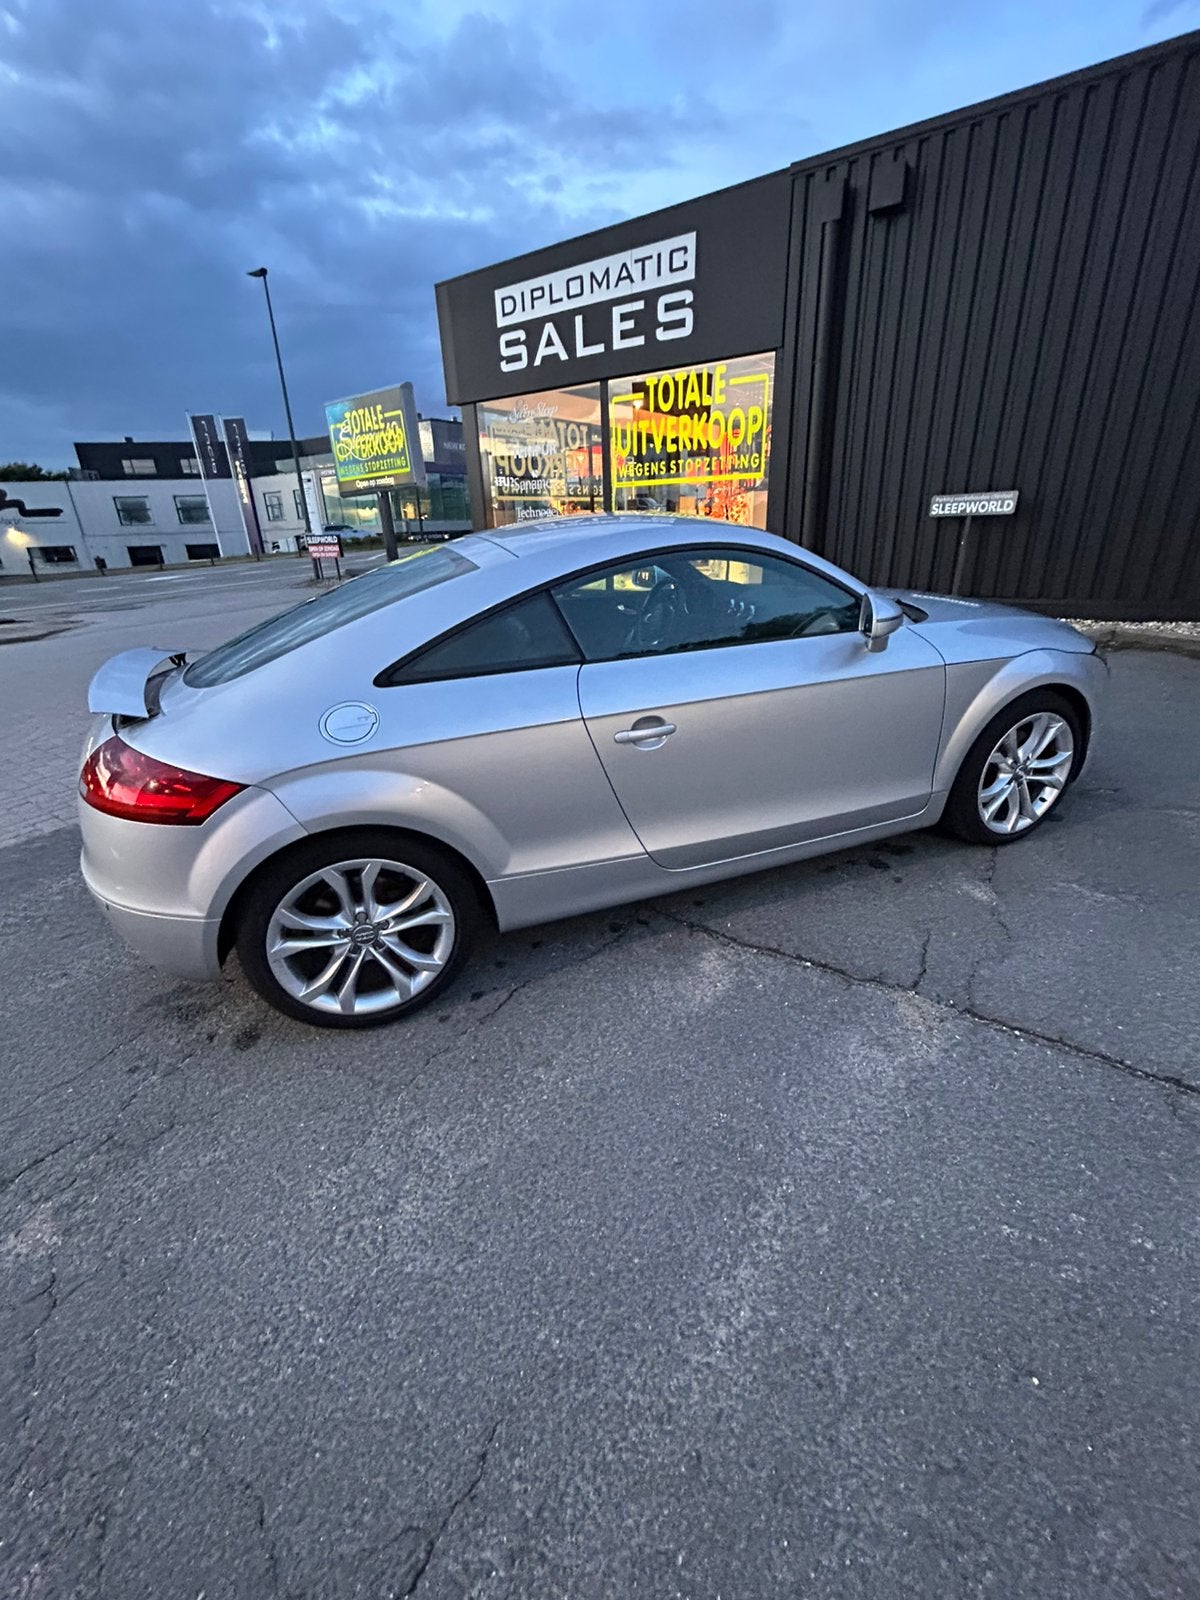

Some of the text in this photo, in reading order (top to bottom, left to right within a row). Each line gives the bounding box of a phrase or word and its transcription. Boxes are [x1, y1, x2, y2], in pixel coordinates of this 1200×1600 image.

[501, 245, 688, 317] DIPLOMATIC
[500, 289, 694, 372] SALES
[645, 364, 727, 413] TOTALE
[344, 404, 385, 434] TOTALE
[616, 406, 763, 458] UITVERKOOP
[617, 453, 760, 479] WEGENS STOPZETTING
[931, 500, 1014, 515] SLEEPWORLD
